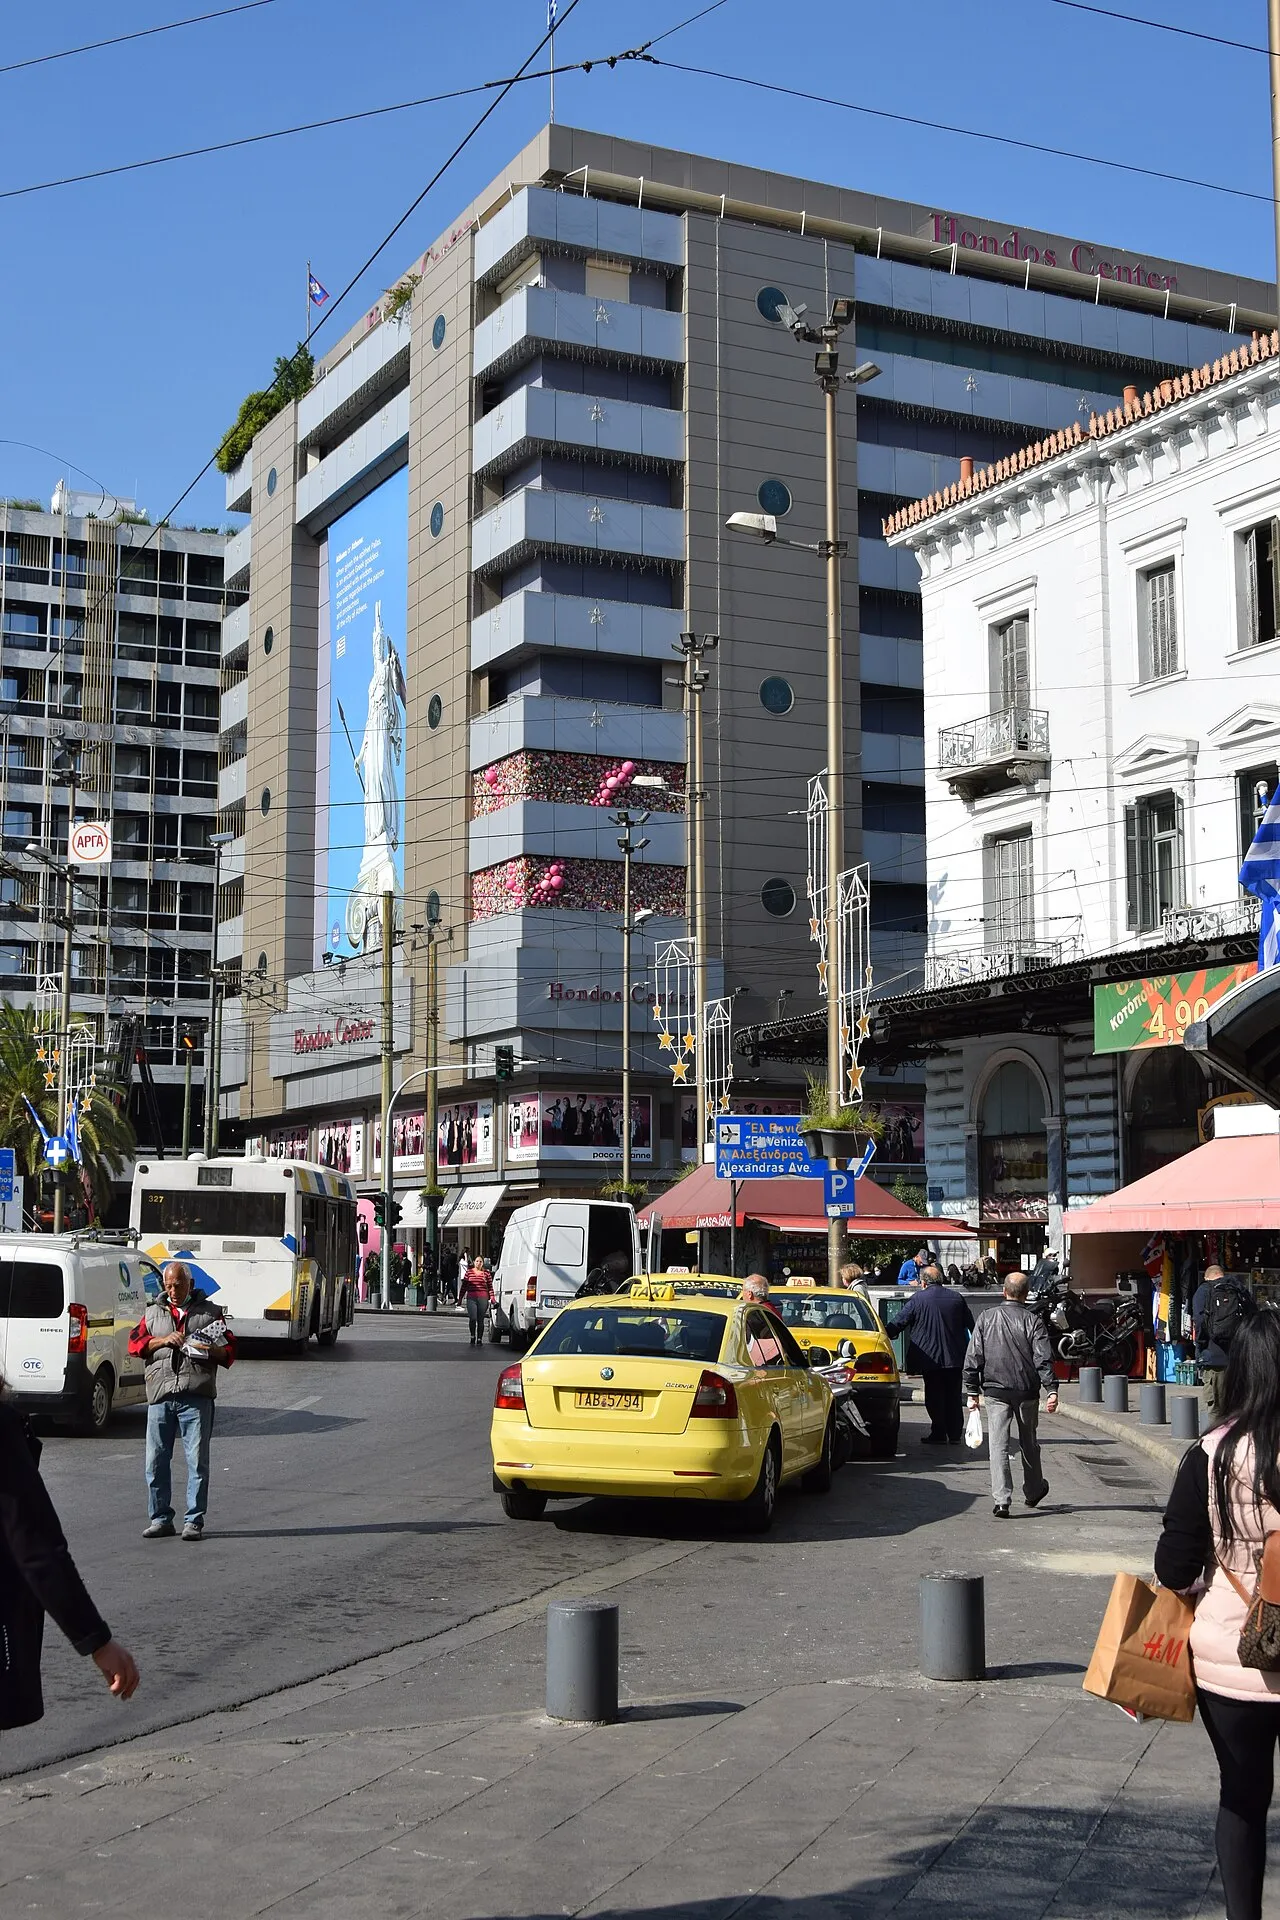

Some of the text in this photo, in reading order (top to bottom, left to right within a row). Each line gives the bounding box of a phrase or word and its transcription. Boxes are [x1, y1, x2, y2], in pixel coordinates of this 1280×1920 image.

[931, 213, 1178, 290] Hondos Center
[548, 981, 622, 1002] Hondos
[295, 1016, 376, 1054] Hondos Center
[769, 1122, 802, 1134] Βενιζ
[767, 1136, 807, 1147] Venize
[732, 1148, 803, 1162] Αλεξάνδρας
[719, 1162, 812, 1174] Alexandras Ave.
[832, 1175, 847, 1197] P
[148, 1195, 164, 1203] 327
[633, 1286, 668, 1298] TAXI
[607, 1392, 640, 1408] 5794
[1143, 1631, 1184, 1668] H&M
